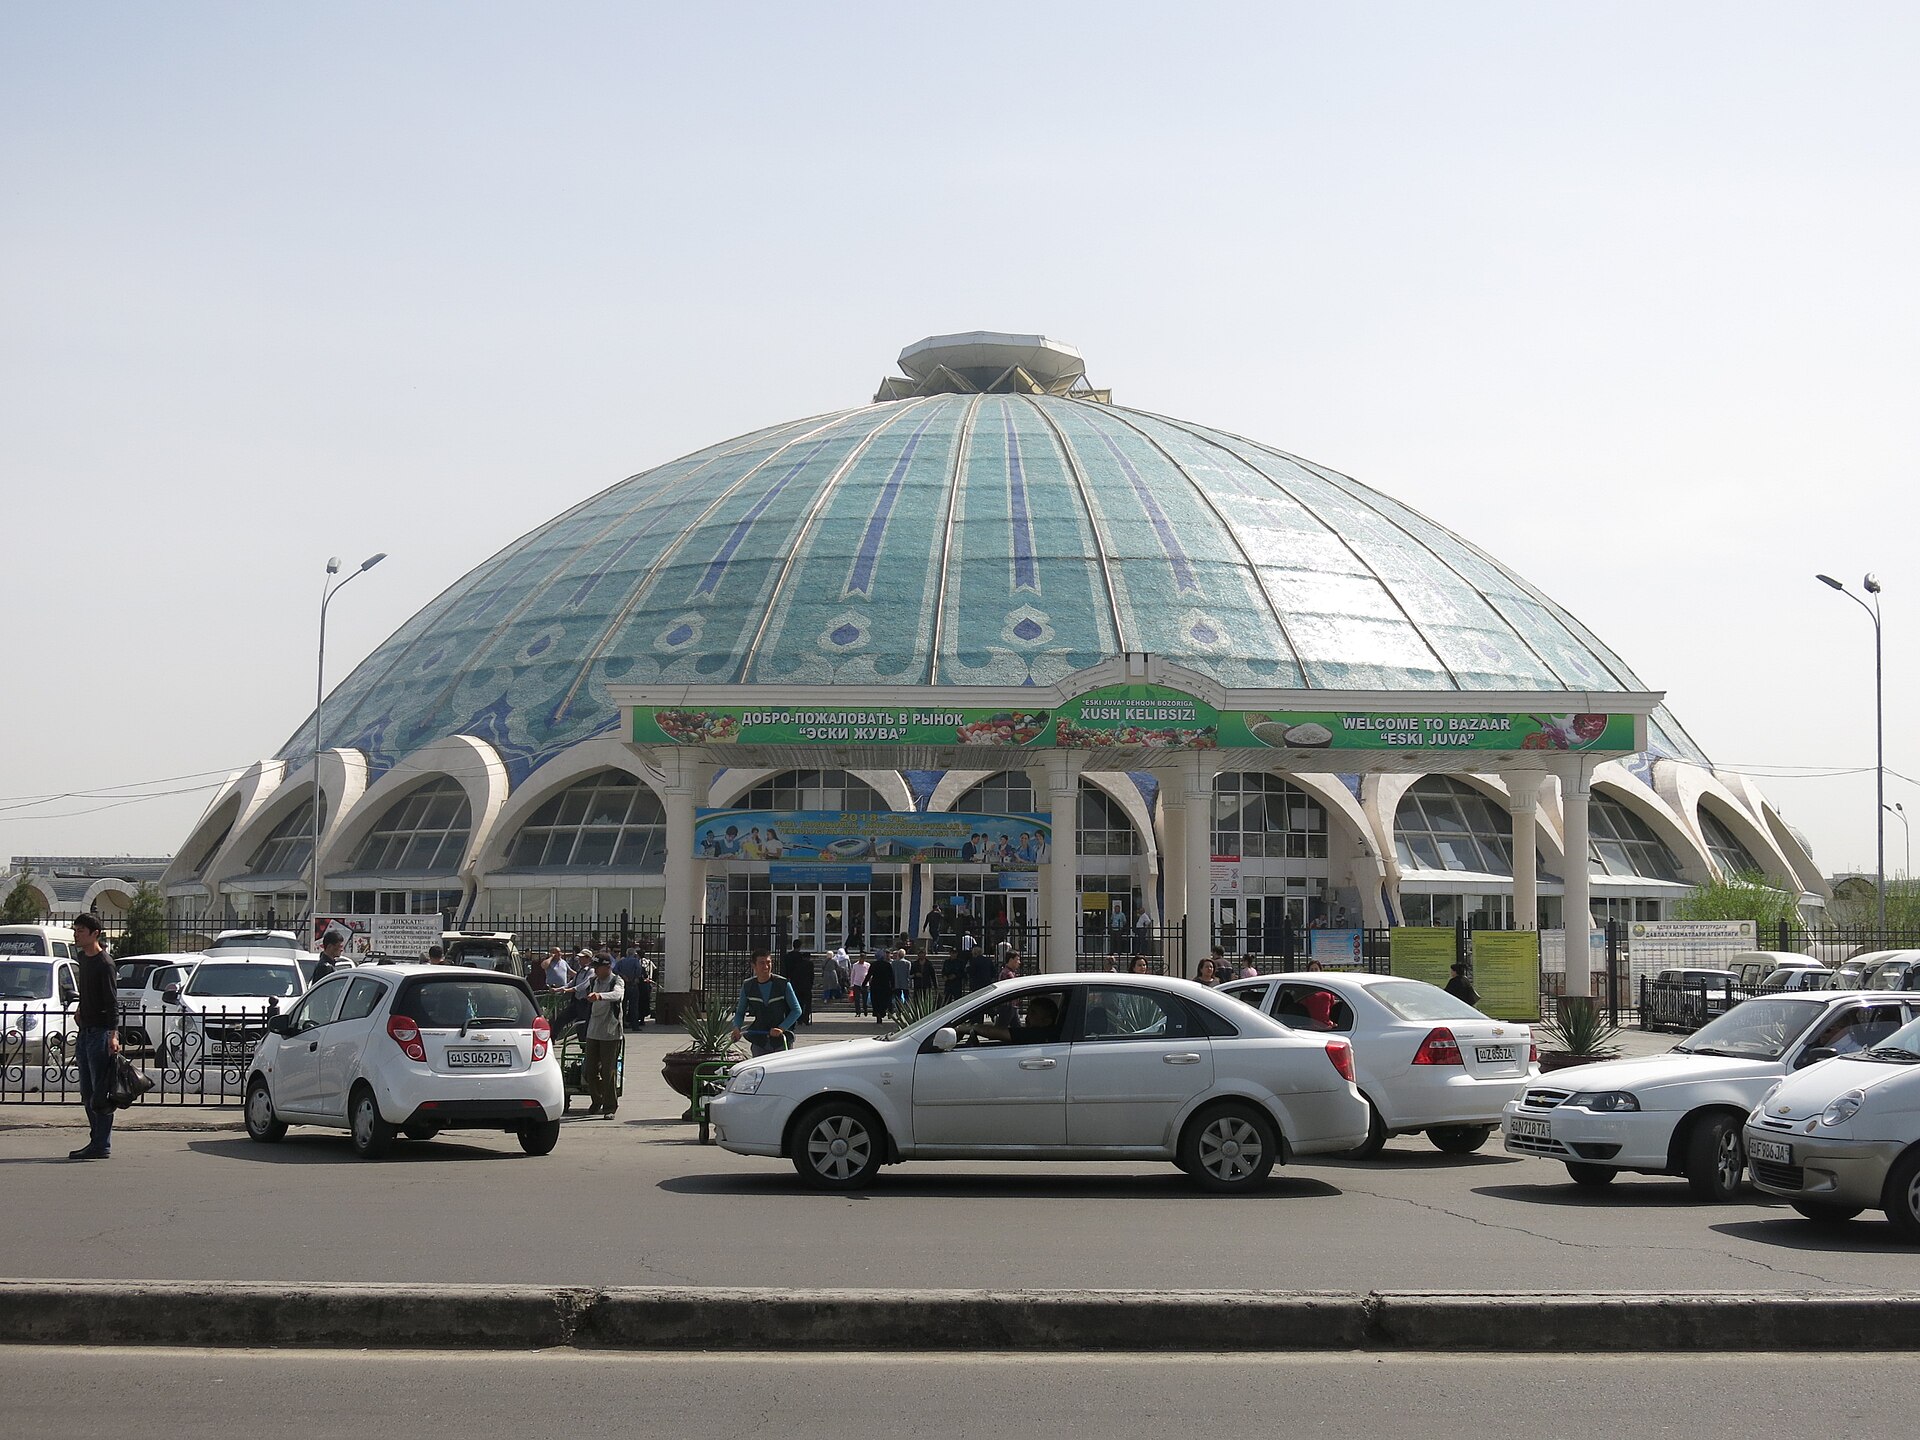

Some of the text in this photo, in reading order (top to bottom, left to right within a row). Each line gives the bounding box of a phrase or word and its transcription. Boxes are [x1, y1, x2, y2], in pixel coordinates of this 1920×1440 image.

[741, 712, 964, 726] ДОБРО-ПОЖАЛОВАТЬ В РЫНОК
[1081, 708, 1196, 720] XUSH KELIBSIZ!
[1343, 717, 1511, 731] WELCOME TO BAZAAR
[799, 727, 907, 740] “ЭСКИ ЖУВА”
[1381, 733, 1475, 746] “ESKI JUVA”
[450, 1052, 505, 1064] 01 S062PA
[1519, 1120, 1546, 1137] N718TA
